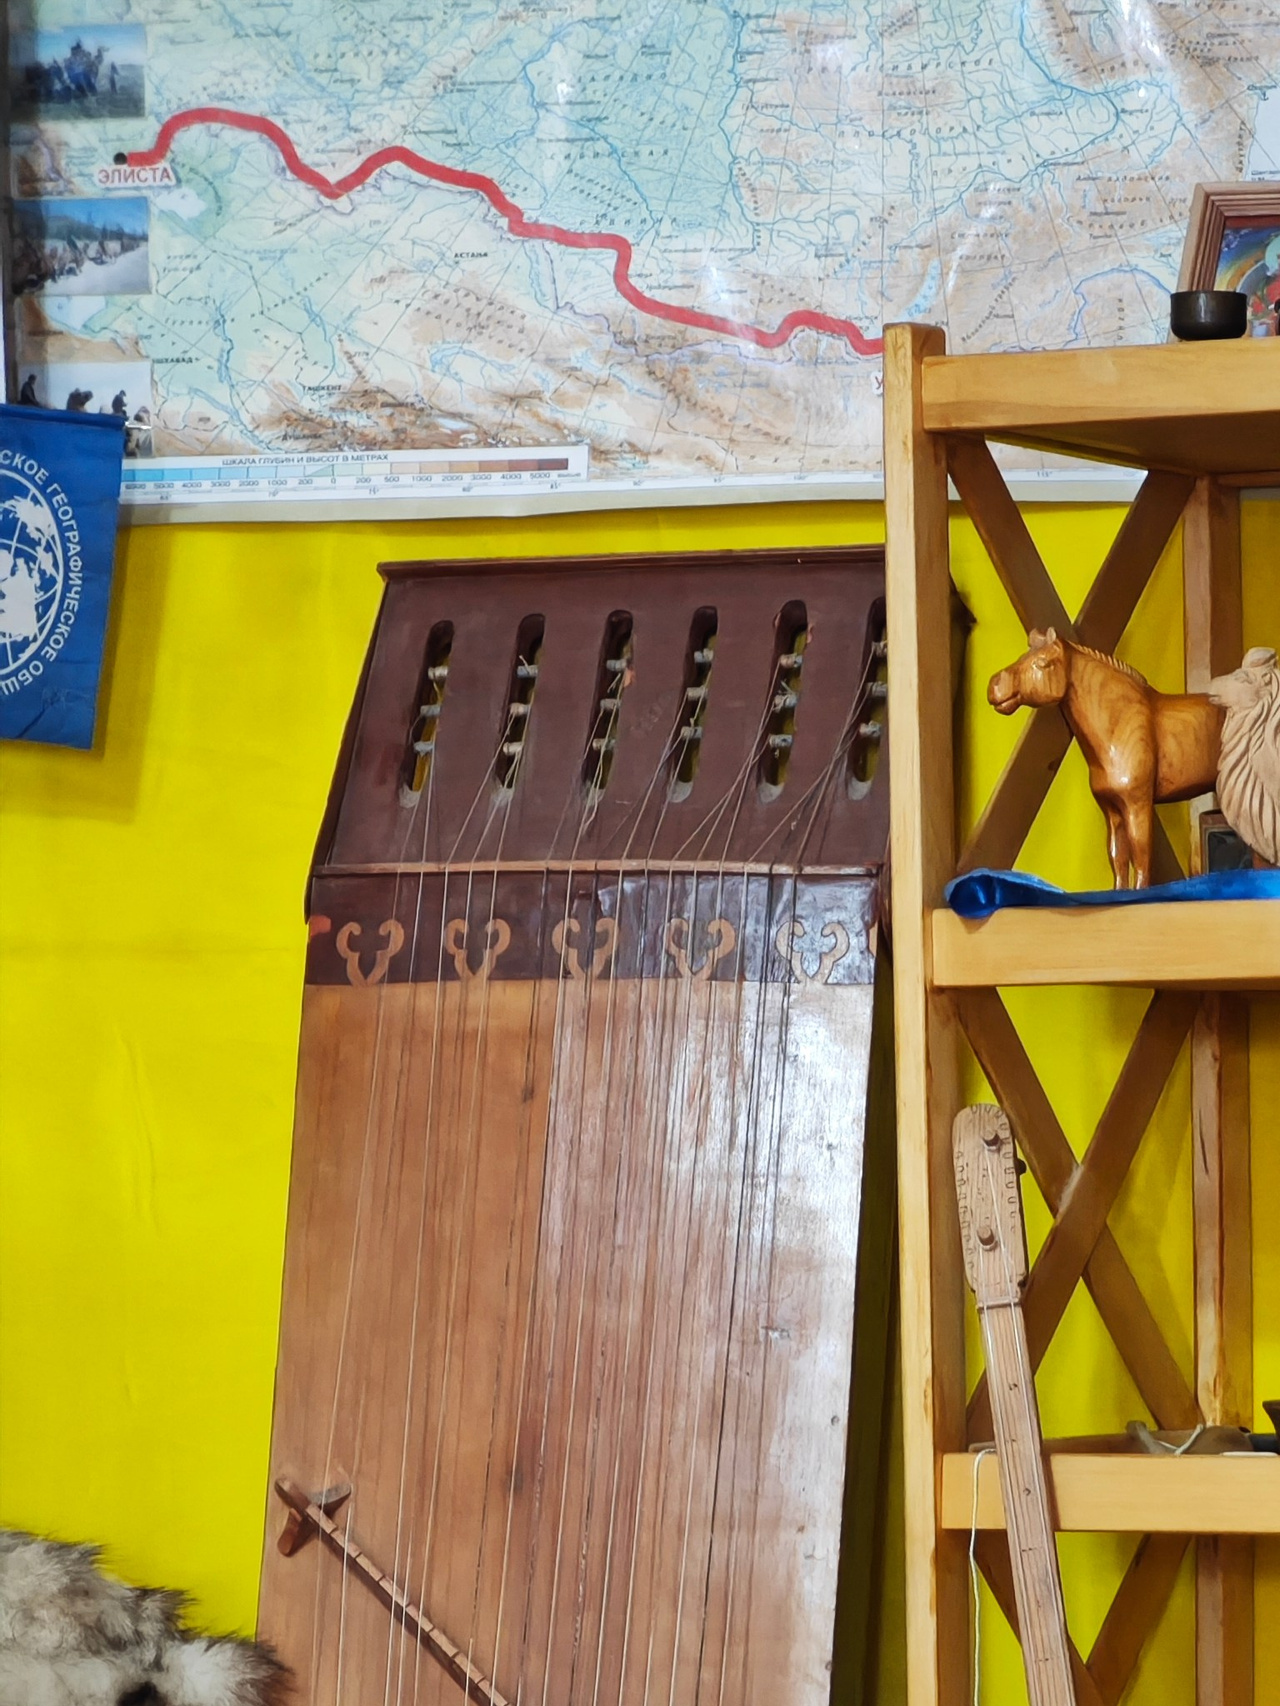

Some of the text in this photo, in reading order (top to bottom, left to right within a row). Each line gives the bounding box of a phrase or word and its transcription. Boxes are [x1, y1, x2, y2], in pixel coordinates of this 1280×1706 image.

[98, 166, 173, 185] ЭЛИСТА
[222, 453, 389, 466] ШКАЛА ГЛУБИН И ВЫСОТ В МЕТРАХ
[356, 476, 372, 484] 200
[384, 475, 401, 483] 500
[529, 472, 551, 480] 5000
[41, 482, 83, 662] ГЕОГРАФИЧЕСКОЕ
